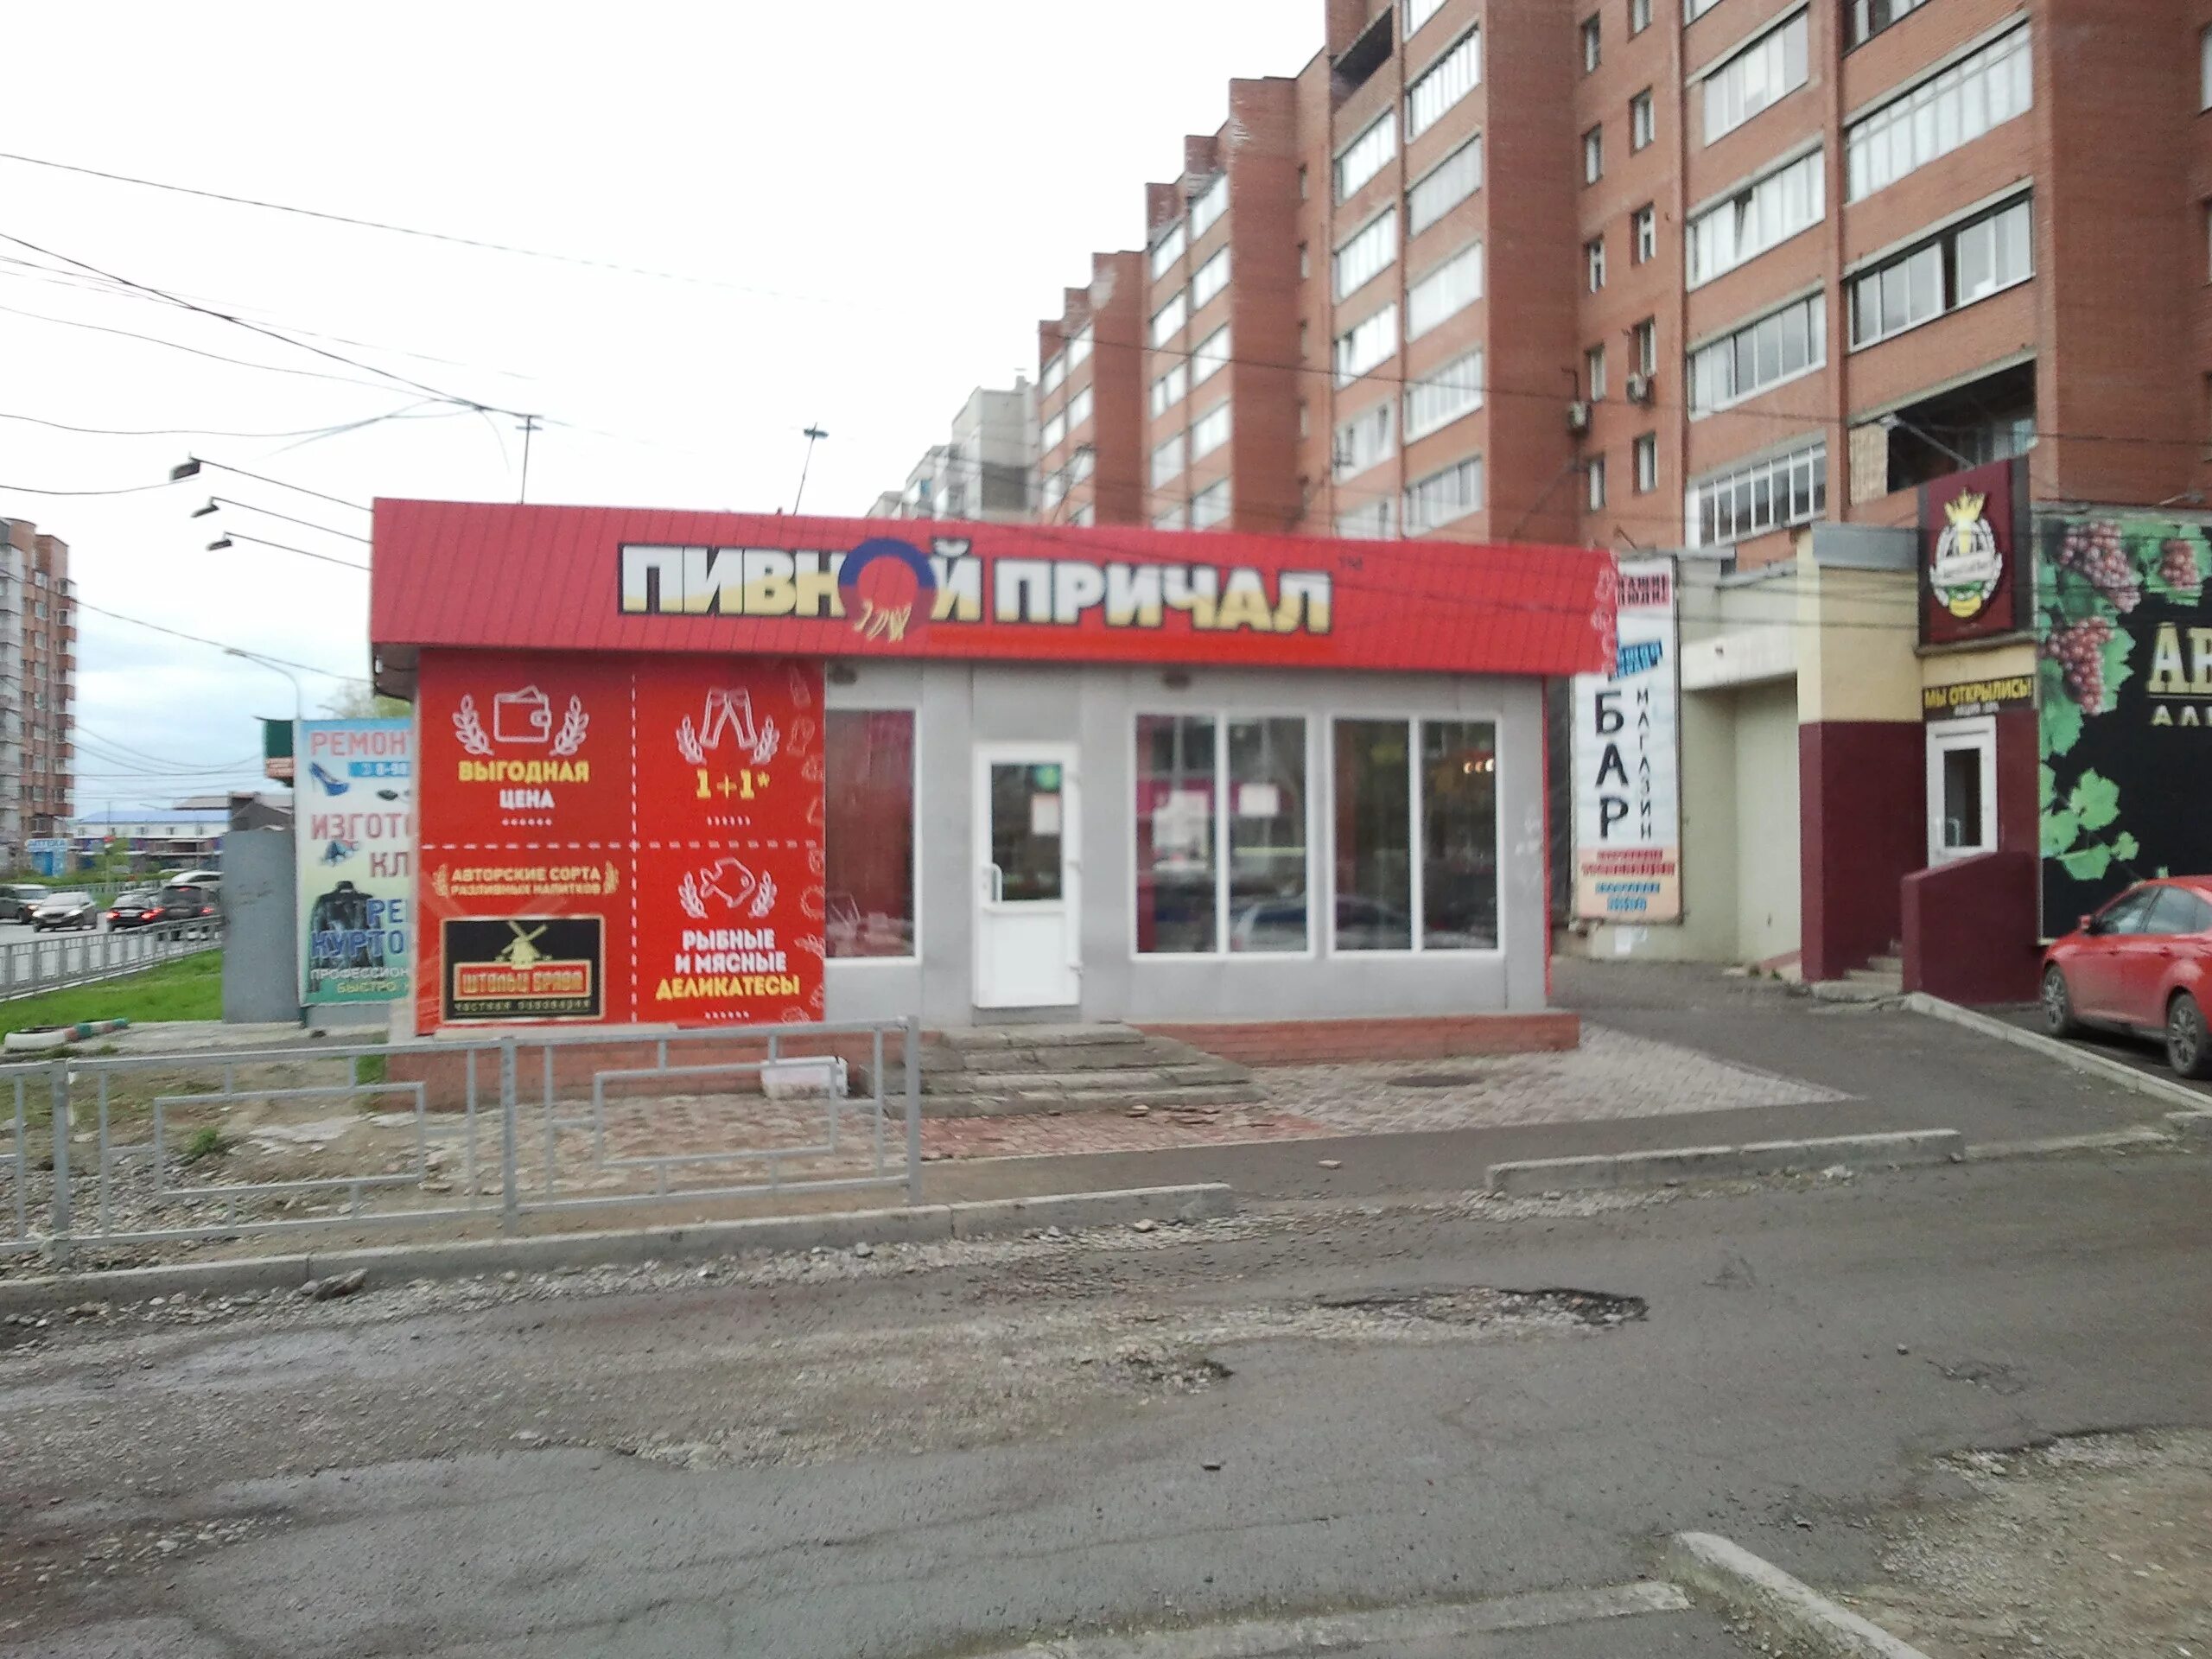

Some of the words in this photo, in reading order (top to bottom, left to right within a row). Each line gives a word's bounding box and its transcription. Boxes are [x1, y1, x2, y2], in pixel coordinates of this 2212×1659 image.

[619, 536, 983, 629] ПИВНОЙ
[992, 556, 1333, 635] ПРИЧАЛ
[458, 760, 591, 785] ВЫГОДНАЯ
[1595, 690, 1630, 841] БАР
[499, 788, 556, 810] ЦЕНА
[451, 868, 546, 882] АВТОРСКИЕ
[549, 866, 601, 881] СОРТА
[682, 927, 776, 952] РЫБНЫЕ
[675, 953, 690, 975] И
[694, 950, 788, 975] МЯСНЫЕ
[654, 975, 801, 1001] ДЕЛИКАТЕСЫ
